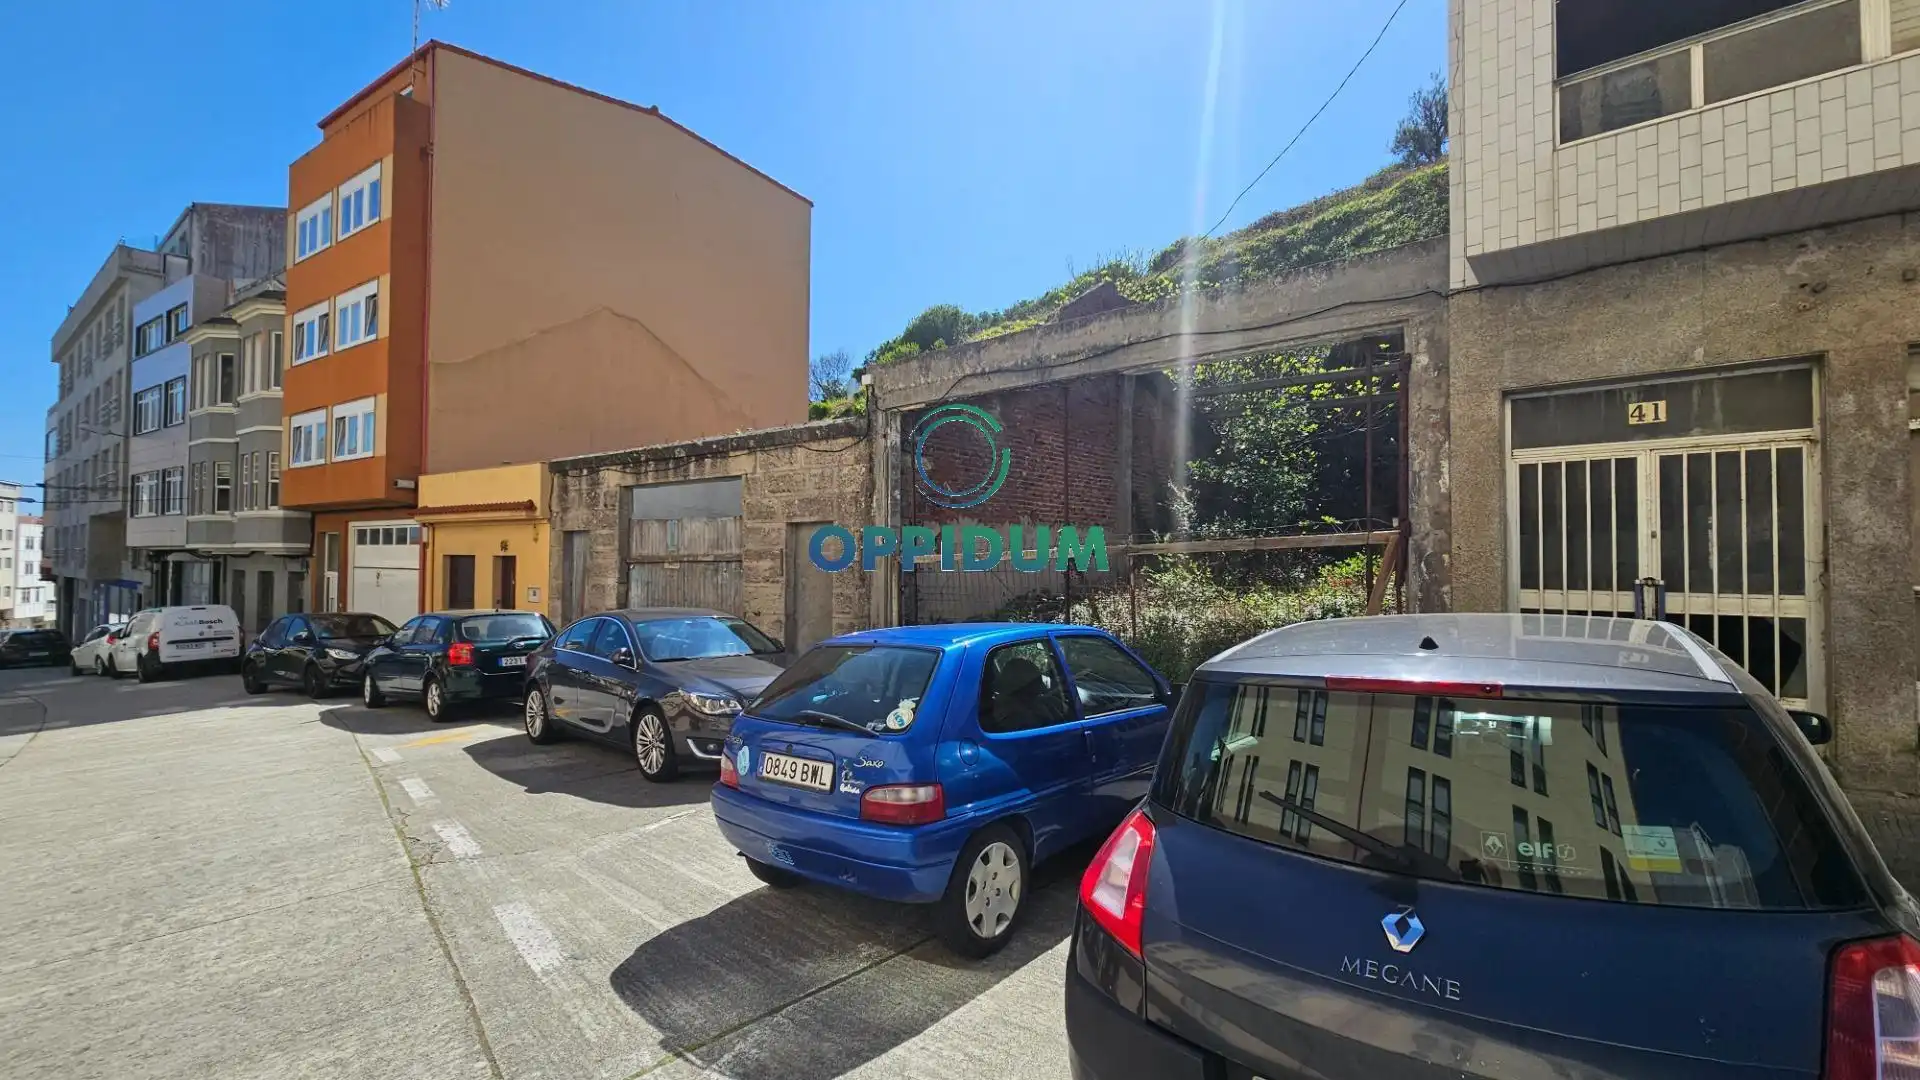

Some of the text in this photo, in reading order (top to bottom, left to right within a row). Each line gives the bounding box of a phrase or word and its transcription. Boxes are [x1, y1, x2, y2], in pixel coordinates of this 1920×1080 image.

[1630, 402, 1662, 423] 41
[765, 756, 827, 786] 0849 BWL
[853, 756, 884, 769] Saxo
[1517, 842, 1554, 859] elf
[1340, 955, 1461, 1001] MEGANE
